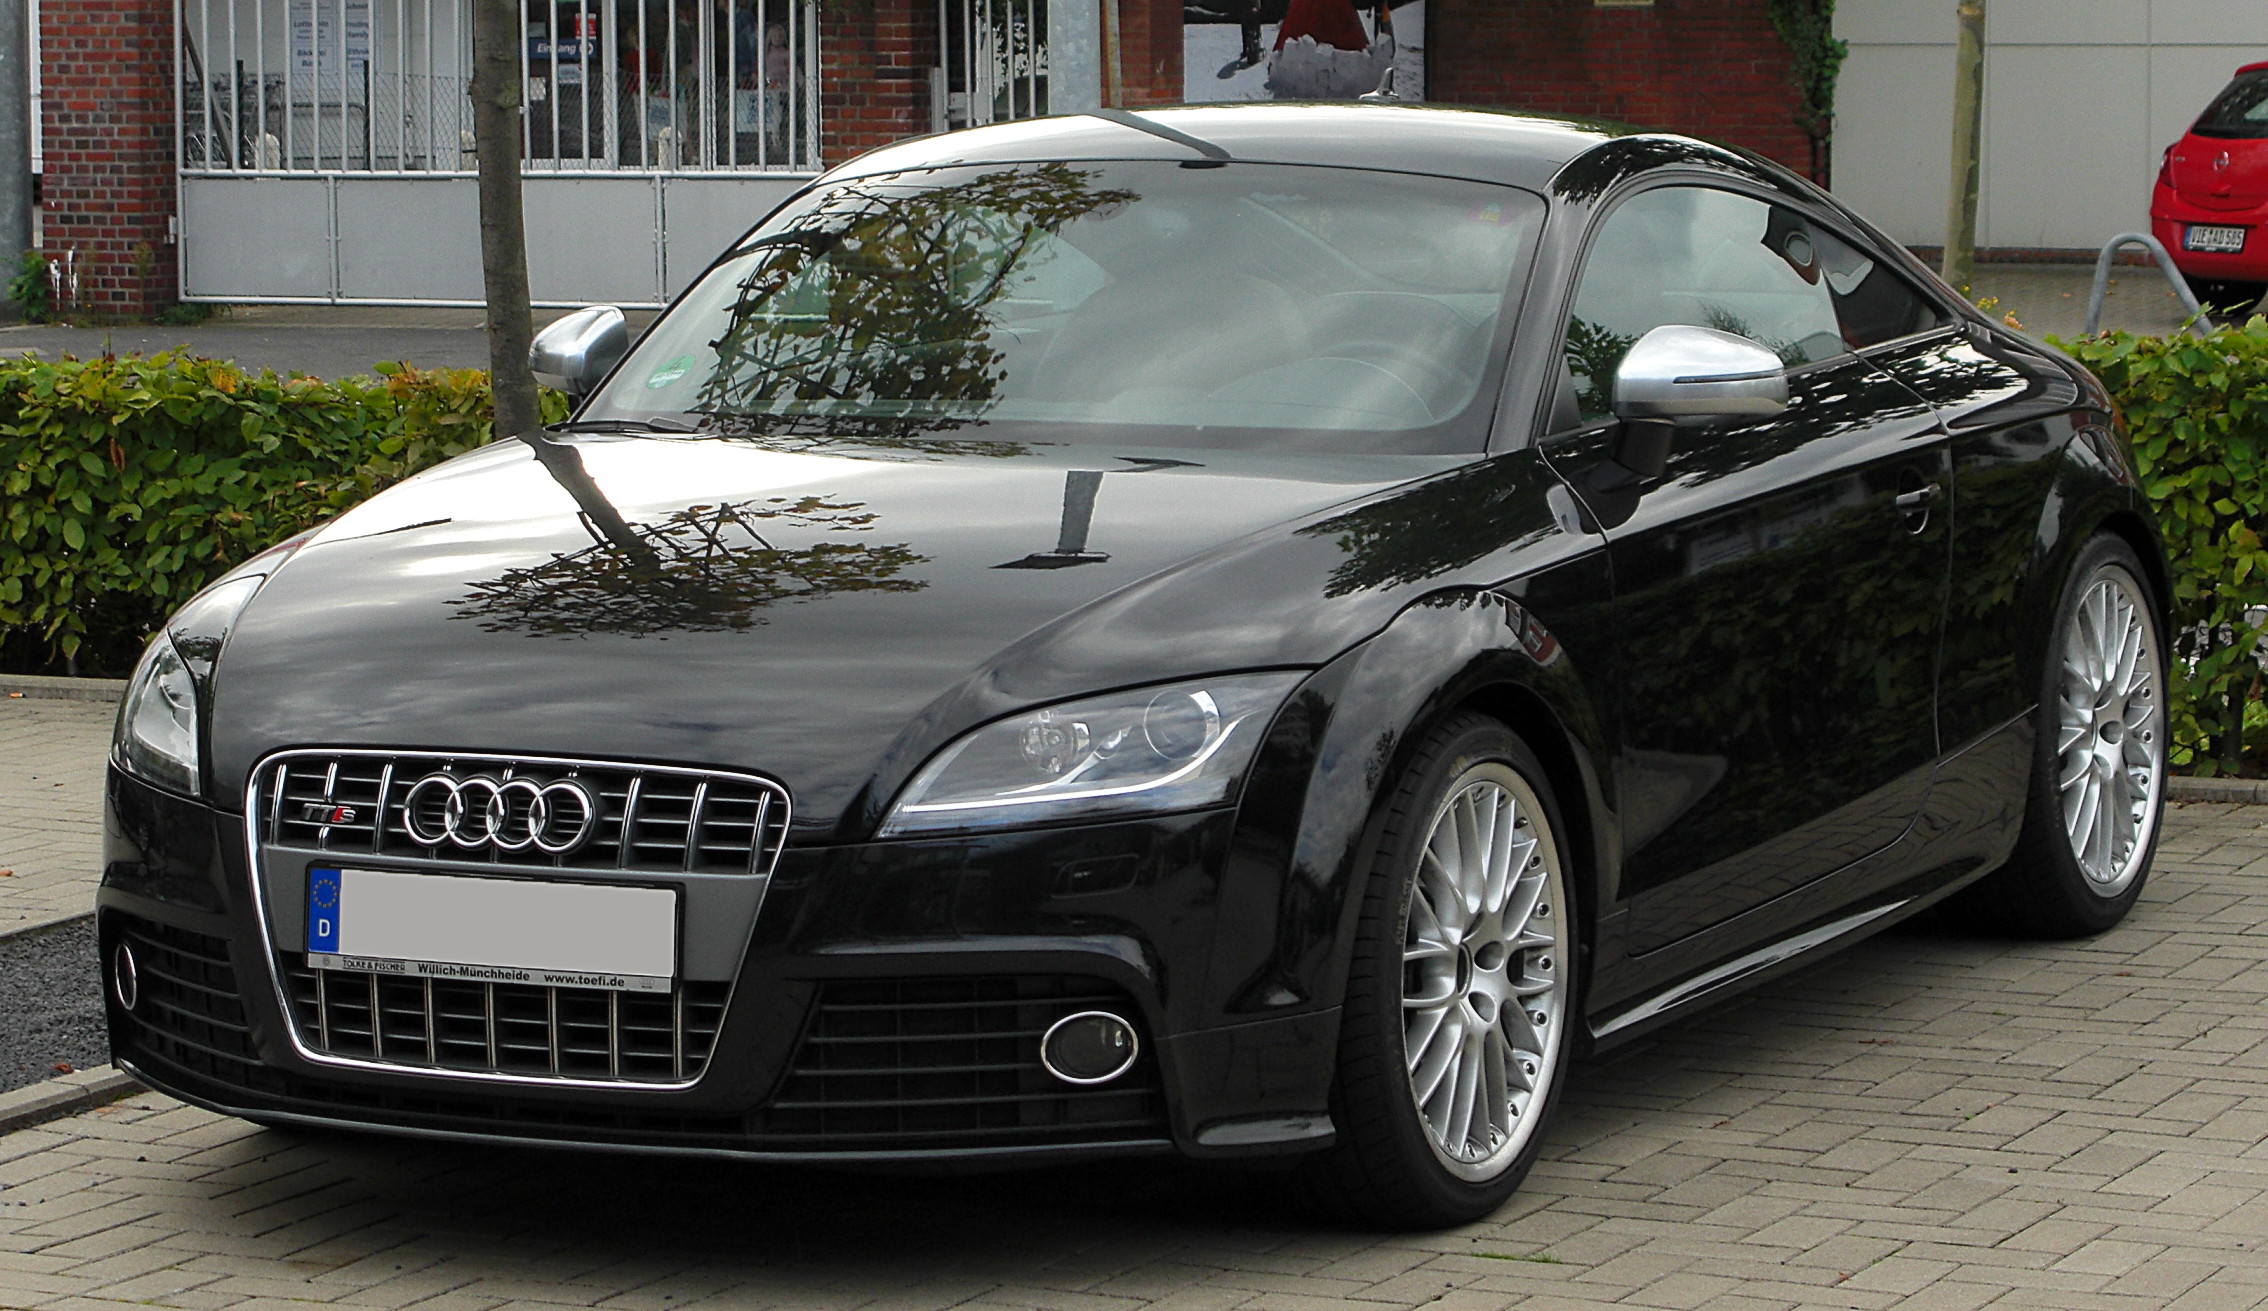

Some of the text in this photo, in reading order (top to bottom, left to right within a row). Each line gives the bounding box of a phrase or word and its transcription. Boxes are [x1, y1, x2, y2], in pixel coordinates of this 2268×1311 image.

[537, 43, 577, 55] Einang
[303, 803, 356, 823] TTS
[318, 918, 331, 938] D
[417, 963, 531, 981] Willich-Münchheide
[543, 974, 625, 987] www.toefi.de
